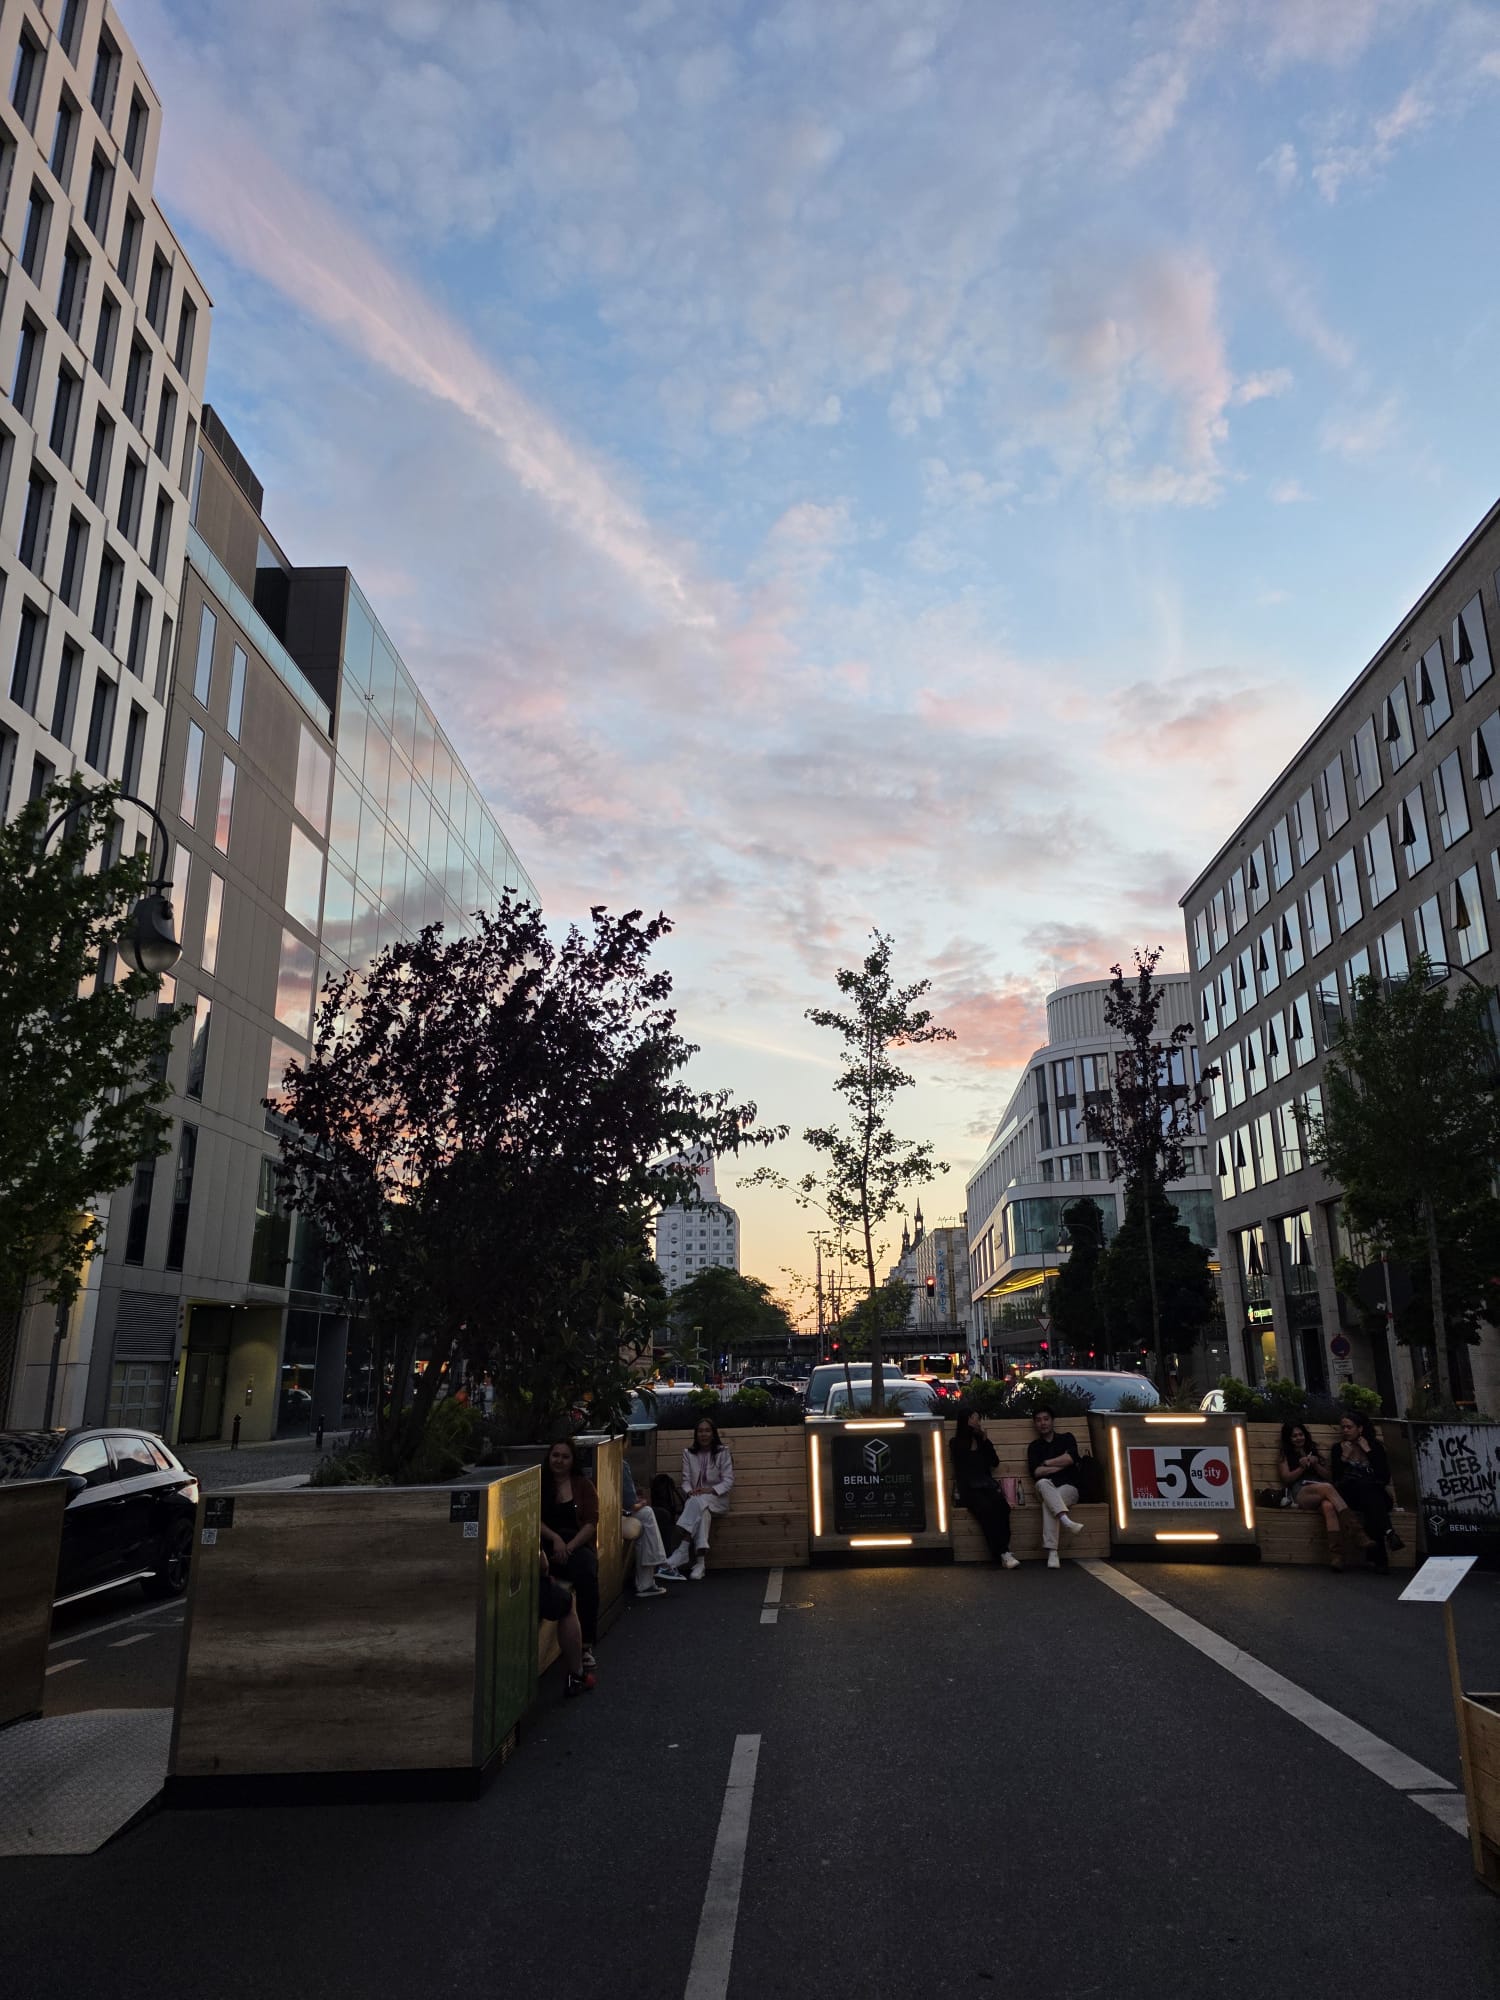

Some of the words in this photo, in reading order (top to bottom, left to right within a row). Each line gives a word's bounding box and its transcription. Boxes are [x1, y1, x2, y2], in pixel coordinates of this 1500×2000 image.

[1438, 1434, 1476, 1458] ICK
[1440, 1456, 1481, 1477] LIEB
[1437, 1470, 1496, 1497] BERLIN!
